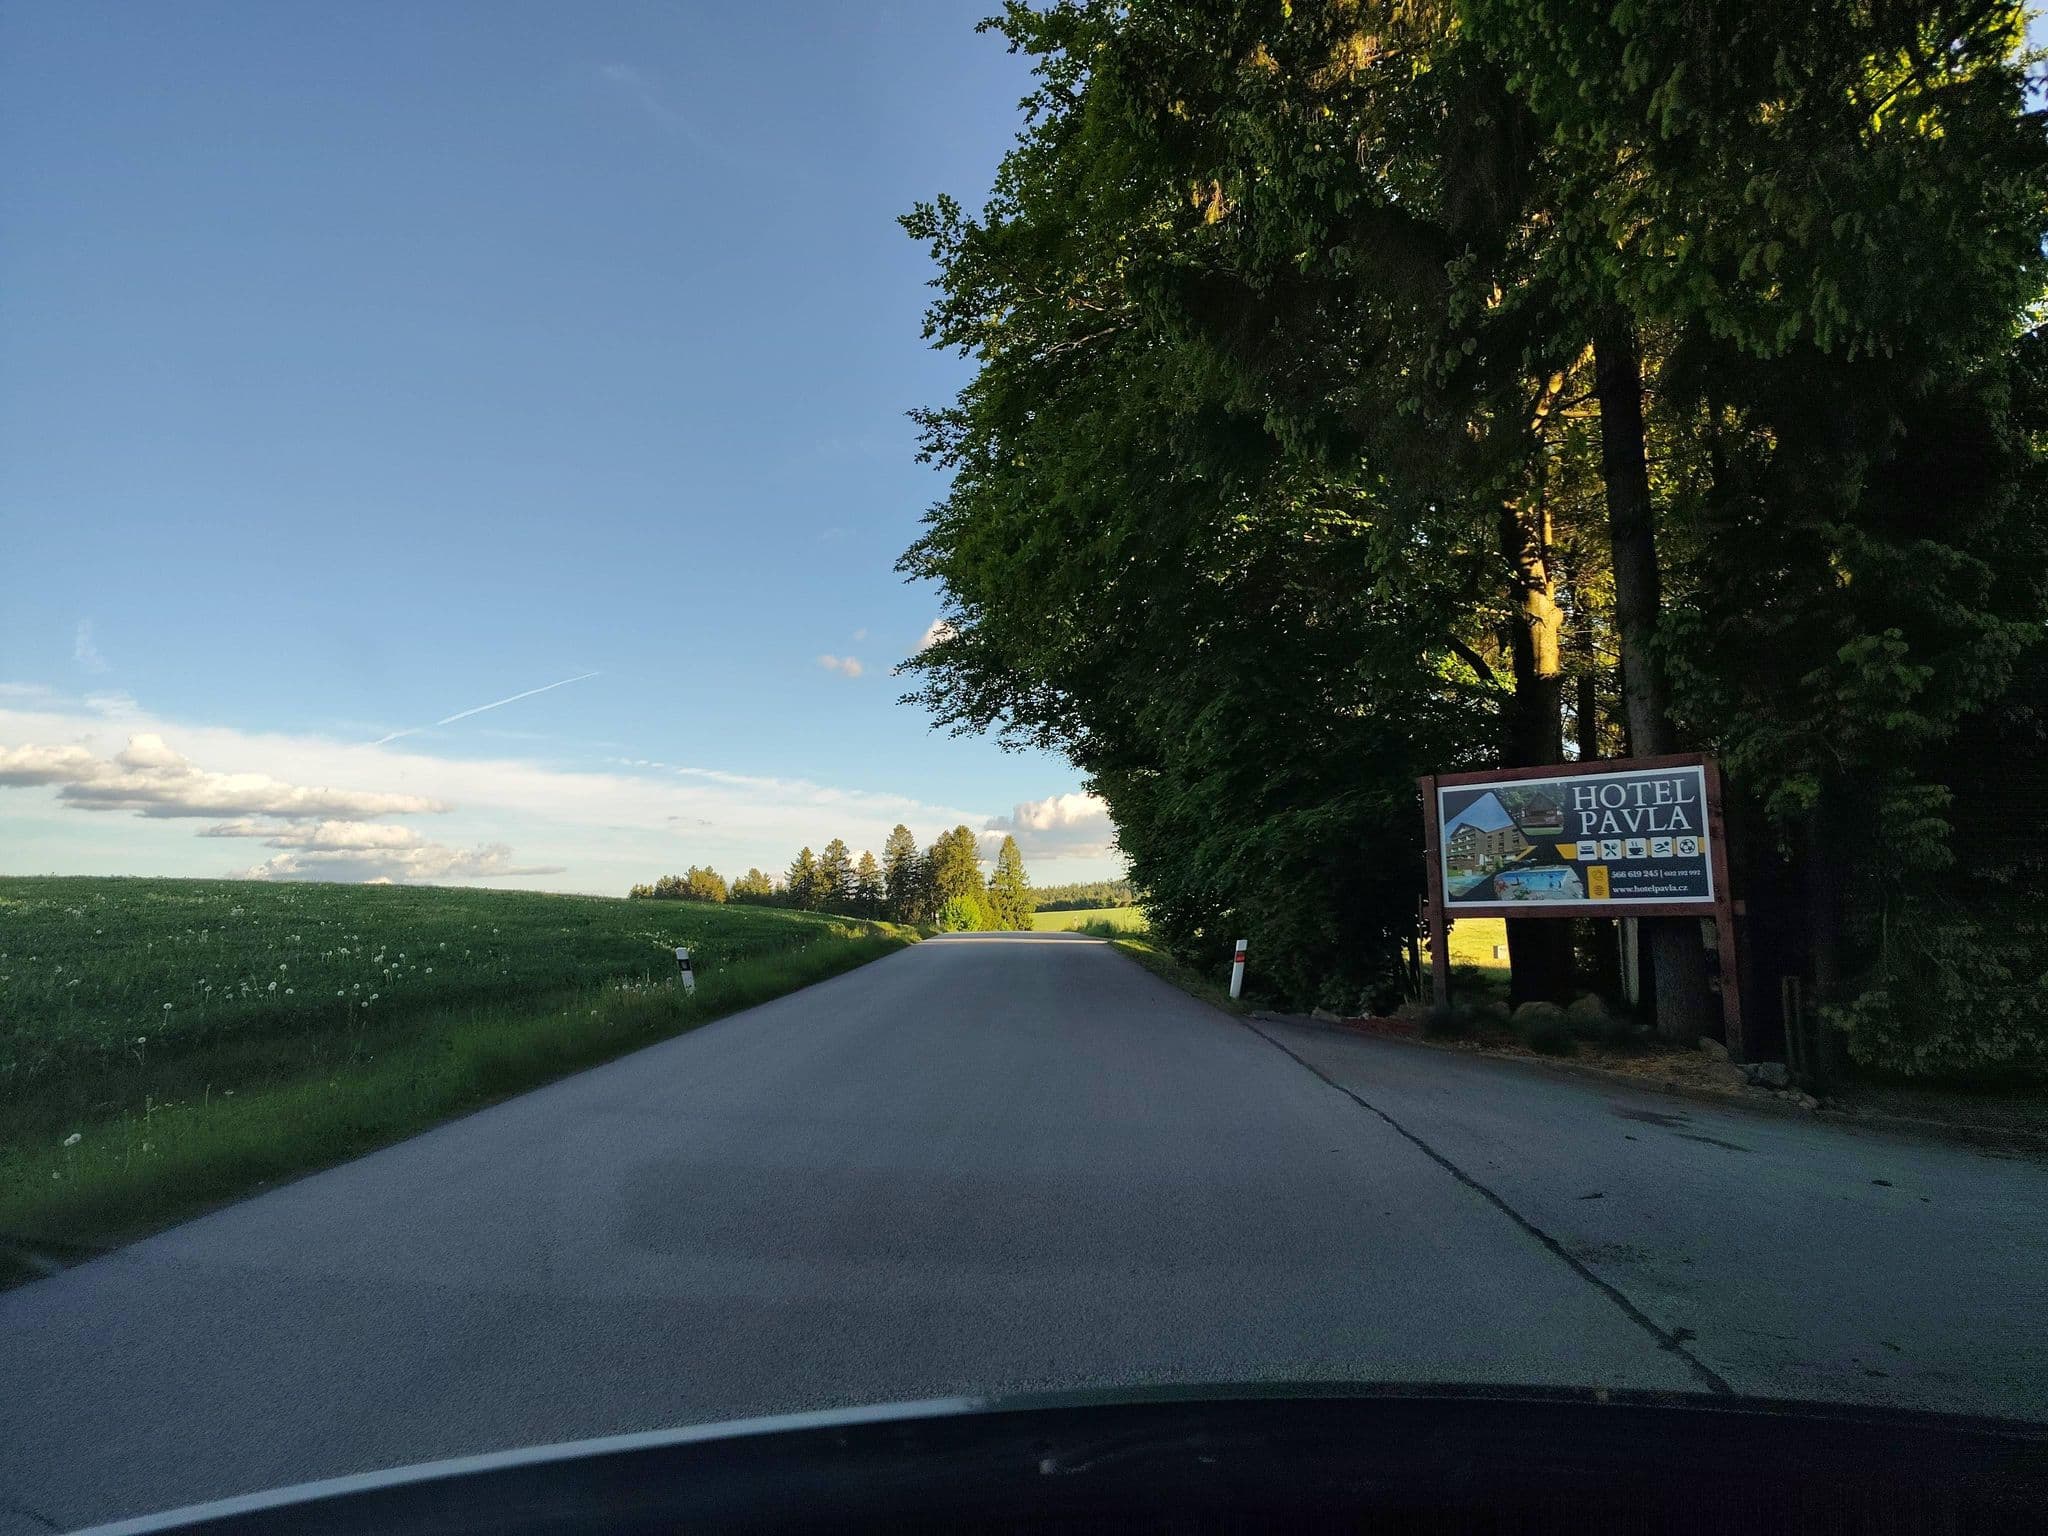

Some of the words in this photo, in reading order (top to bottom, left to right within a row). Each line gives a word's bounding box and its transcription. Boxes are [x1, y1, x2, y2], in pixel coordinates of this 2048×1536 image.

[1572, 779, 1695, 810] HOTEL
[1578, 805, 1692, 835] PAVLA
[1612, 884, 1688, 894] www.hotelpavla.cz
